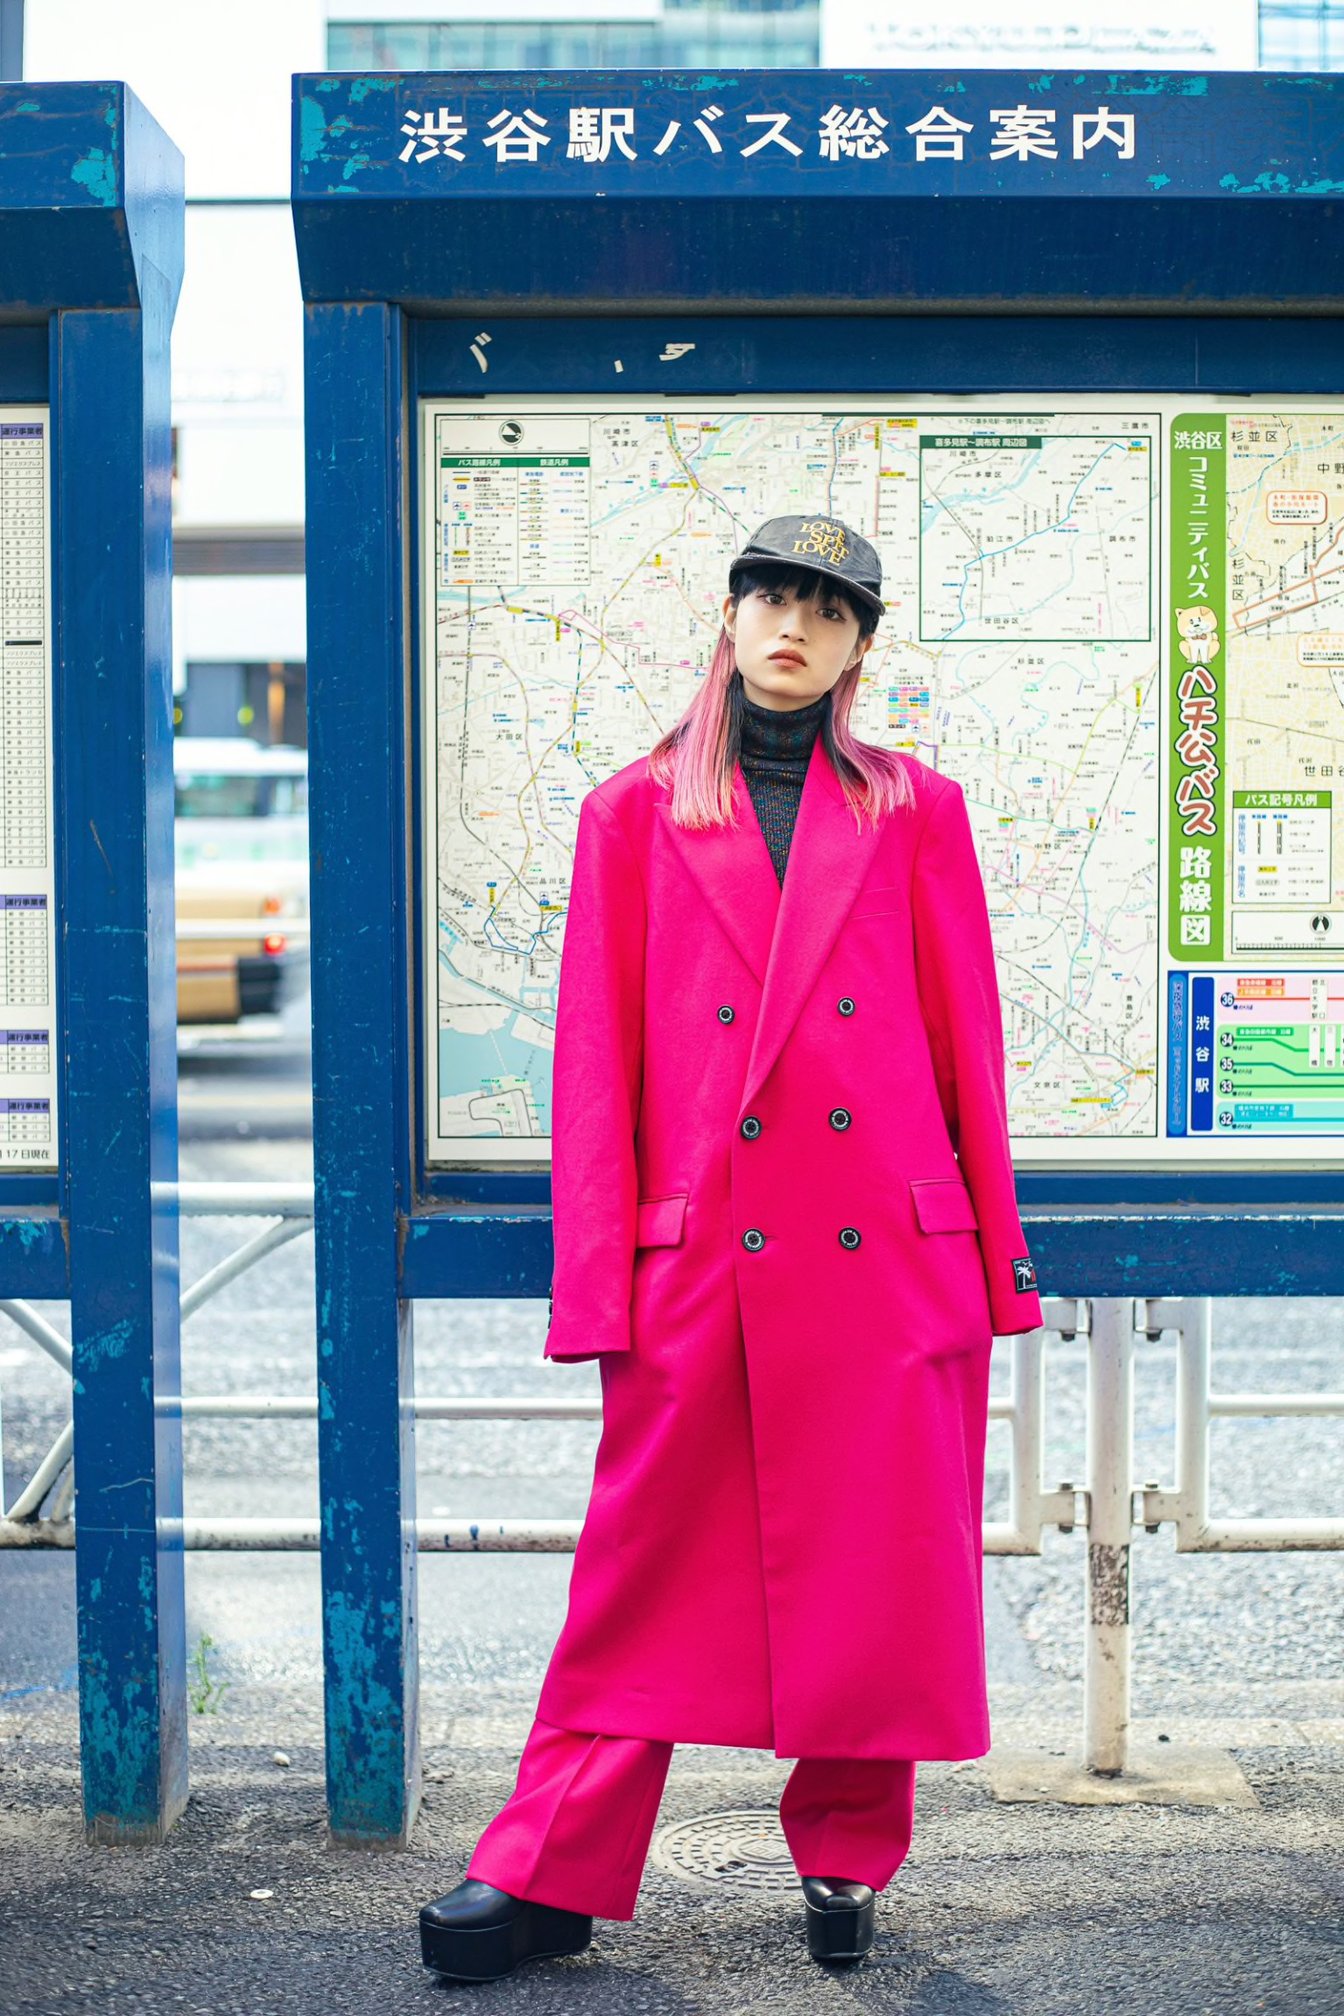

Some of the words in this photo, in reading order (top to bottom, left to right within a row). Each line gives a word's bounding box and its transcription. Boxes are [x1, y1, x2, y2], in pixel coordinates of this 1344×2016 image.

[398, 104, 1136, 164] 渋谷駅バス総合案内
[1174, 431, 1223, 449] 渋谷区
[1230, 430, 1278, 442] 杉並区
[800, 521, 846, 542] LOVE
[1187, 456, 1209, 599] コミュニティバス
[791, 540, 842, 566] LOVE
[1232, 558, 1244, 601] 杉並区
[1176, 667, 1217, 834] ハチ公バス
[1245, 794, 1318, 806] バス記号凡例
[1180, 846, 1212, 945] 路線図
[1222, 993, 1233, 1006] 36
[1221, 1033, 1233, 1046] 34
[1195, 1015, 1210, 1093] 渋谷駅
[1221, 1058, 1233, 1070] 35
[1221, 1080, 1233, 1092] 33
[1221, 1113, 1232, 1125] 32
